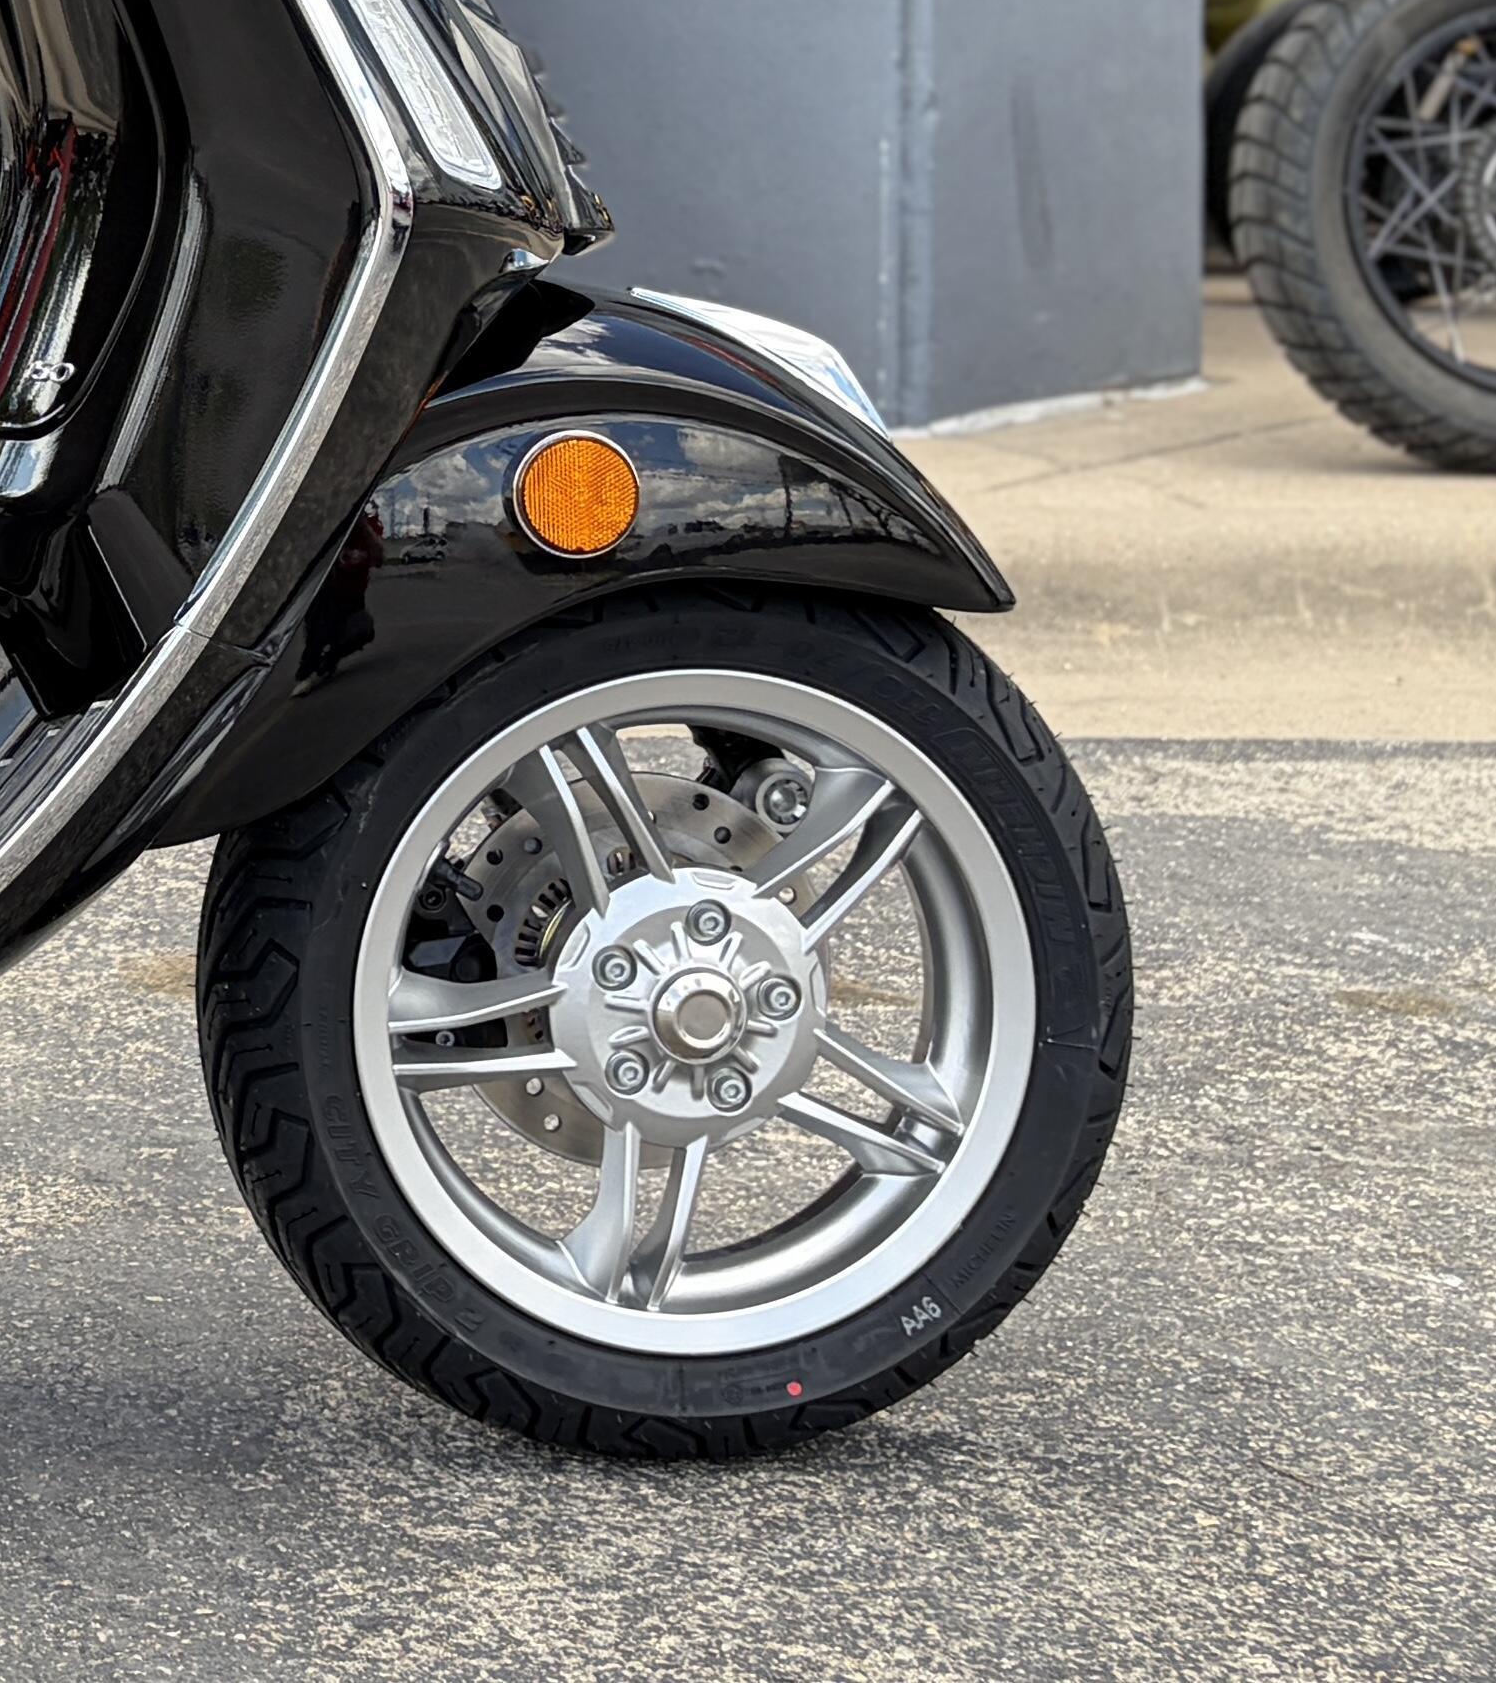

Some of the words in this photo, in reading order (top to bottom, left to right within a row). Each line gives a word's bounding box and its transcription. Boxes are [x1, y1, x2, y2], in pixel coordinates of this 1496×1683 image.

[321, 1093, 382, 1201] CITY
[373, 1215, 456, 1303] GRIP
[900, 1295, 943, 1337] AA6
